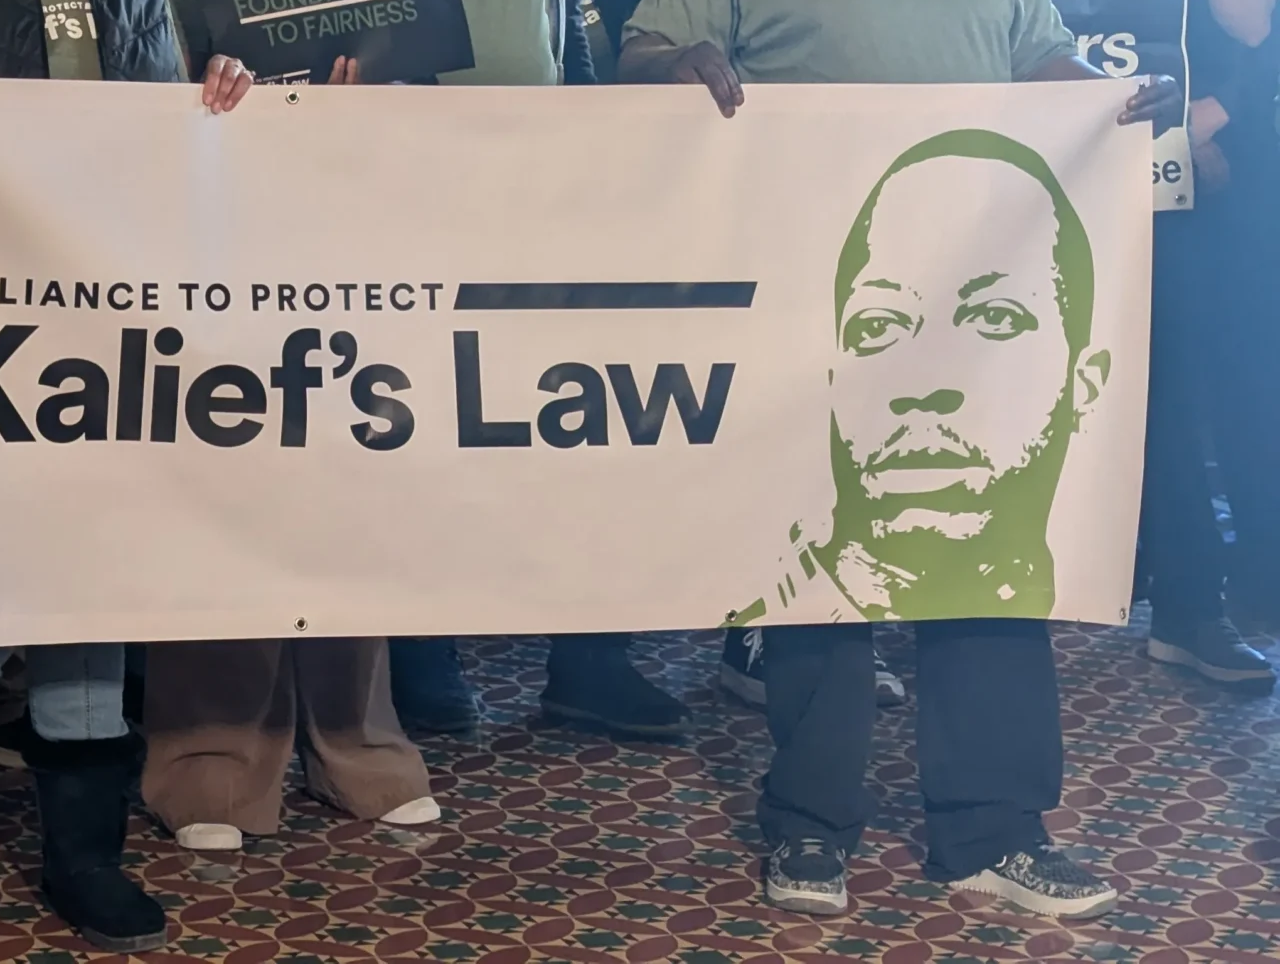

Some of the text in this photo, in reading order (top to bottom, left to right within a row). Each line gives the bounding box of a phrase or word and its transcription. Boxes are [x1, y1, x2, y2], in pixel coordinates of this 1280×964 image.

[42, 1, 83, 13] ROTECT
[261, 0, 418, 47] TO FAIRNESS
[178, 282, 231, 311] TO
[251, 282, 444, 312] PROTECT
[453, 330, 737, 449] Law
